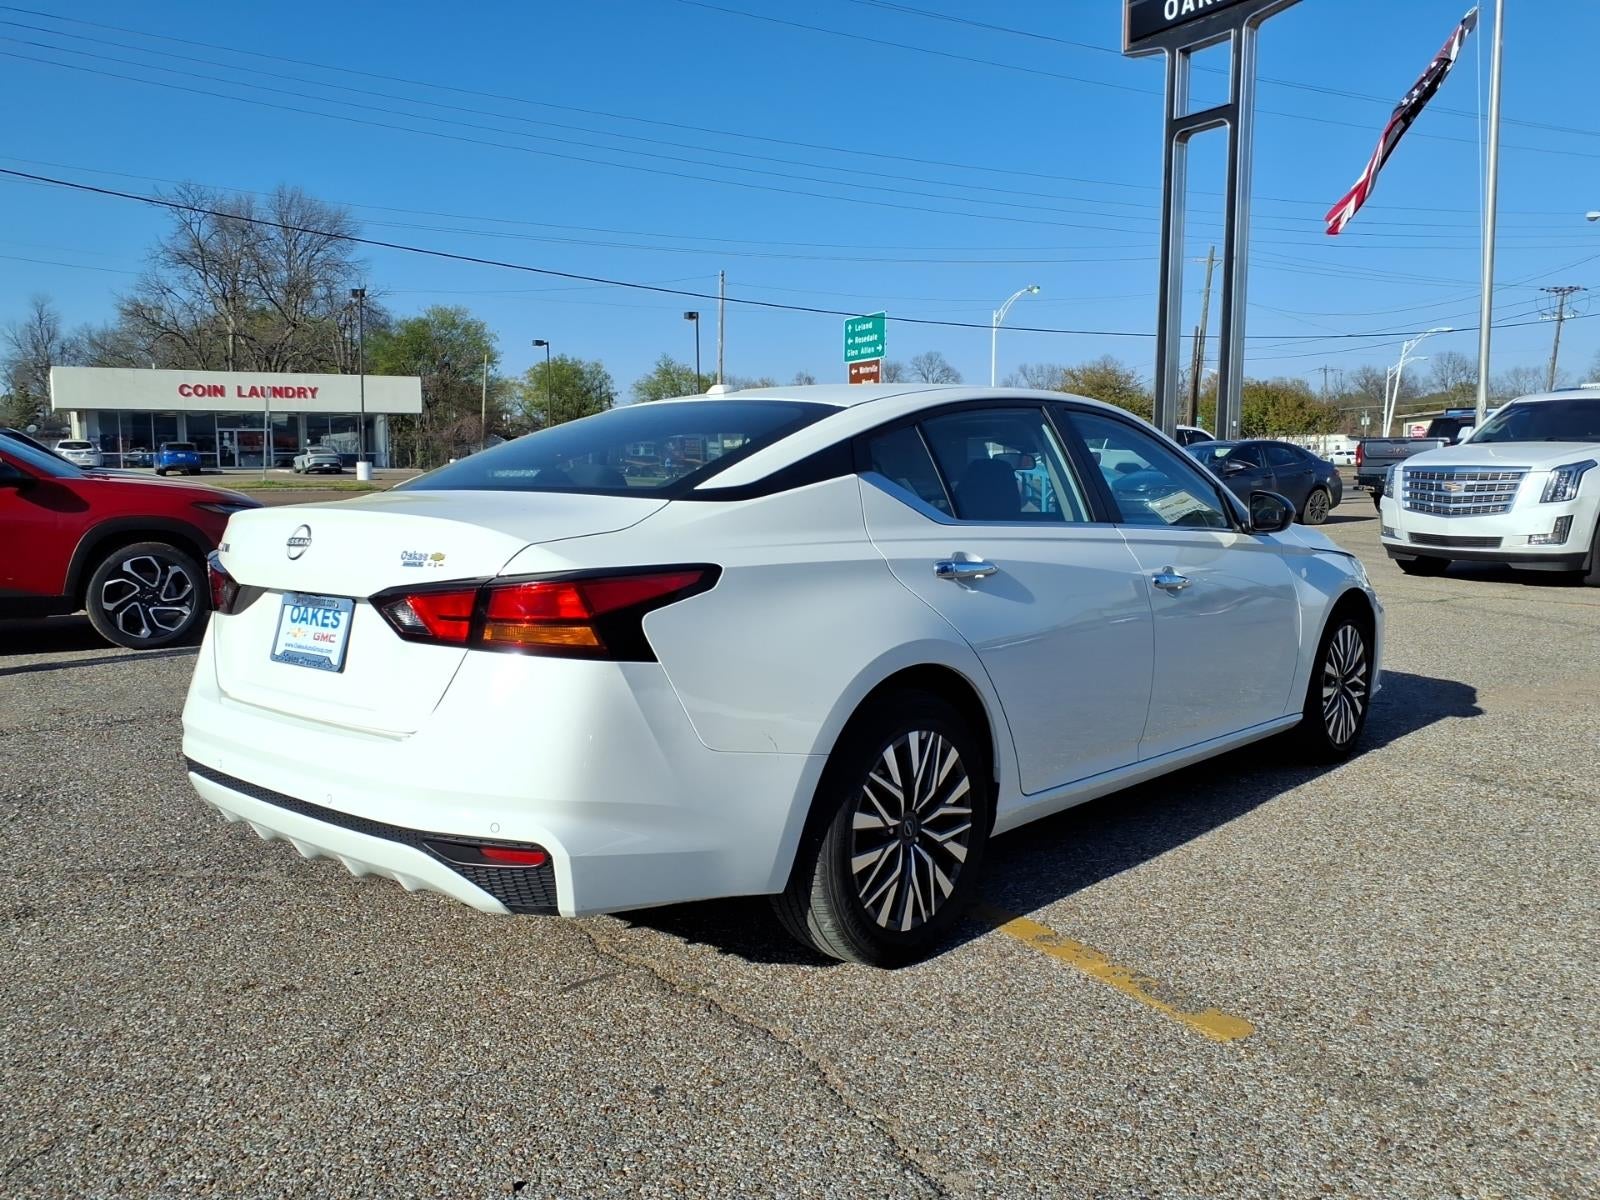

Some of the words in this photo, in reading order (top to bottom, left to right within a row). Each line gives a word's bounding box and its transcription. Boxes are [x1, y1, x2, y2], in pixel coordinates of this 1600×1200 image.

[1164, 0, 1221, 20] OA
[855, 334, 878, 344] Rosedale
[178, 383, 226, 398] COIN
[236, 385, 319, 399] LAUNDRY
[290, 605, 341, 628] OAKES
[313, 632, 336, 643] GMC
